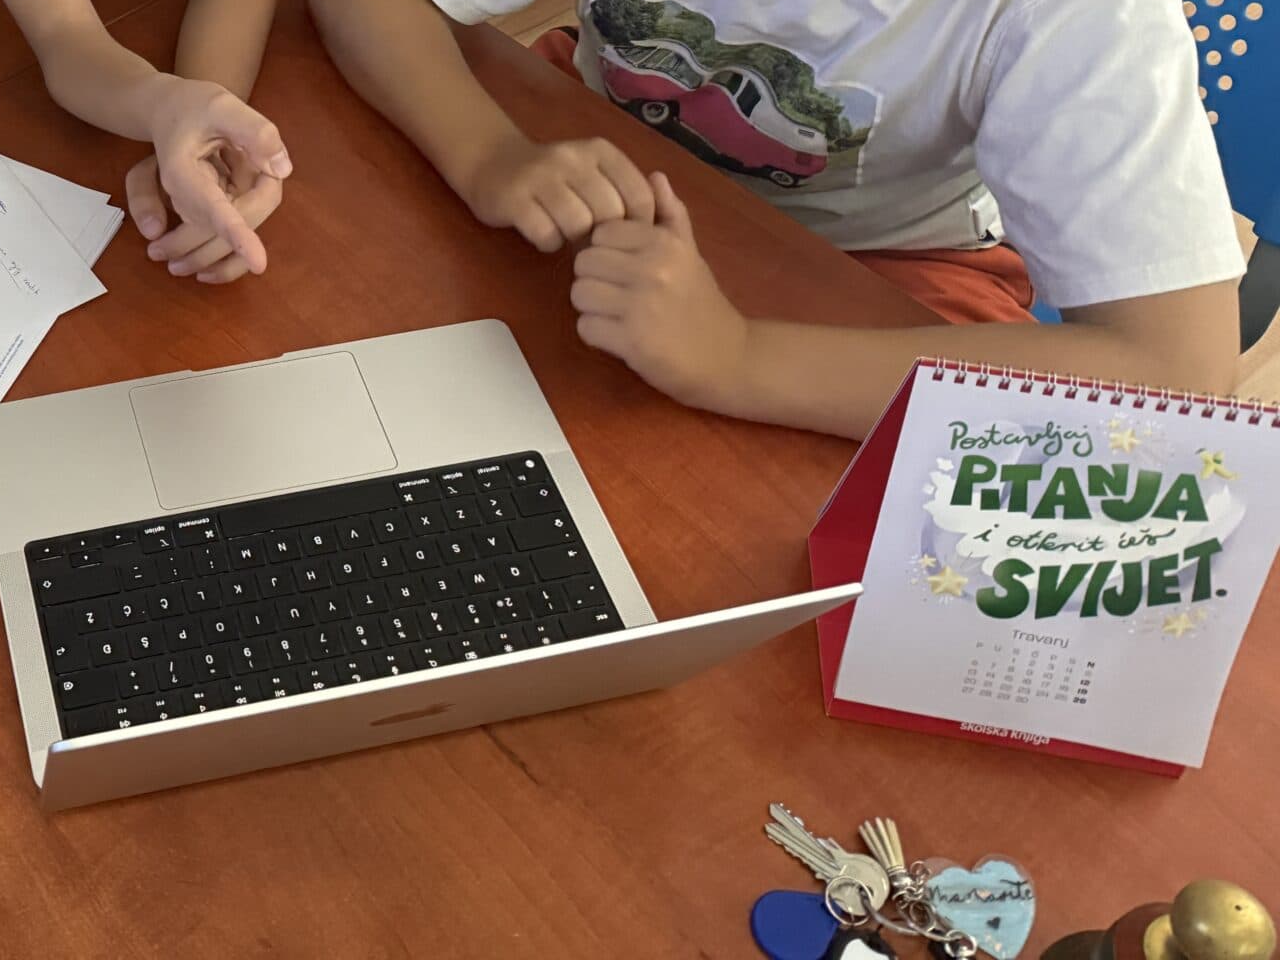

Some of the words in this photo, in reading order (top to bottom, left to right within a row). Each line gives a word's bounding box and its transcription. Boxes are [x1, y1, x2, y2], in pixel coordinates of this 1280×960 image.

[948, 421, 1093, 458] Postavljaj
[950, 454, 1208, 523] PITANJA
[456, 510, 464, 518] Z
[421, 517, 429, 525] X
[386, 523, 394, 531] C
[351, 530, 358, 538] V
[974, 523, 1000, 543] i
[1006, 529, 1105, 552] otkrit
[314, 536, 322, 544] B
[488, 537, 495, 546] A
[278, 543, 286, 551] N
[452, 544, 460, 552] S
[241, 549, 251, 558] M
[416, 551, 424, 559] D
[382, 558, 387, 566] F
[344, 564, 352, 573] G
[511, 568, 519, 576] Q
[307, 571, 315, 580] H
[474, 574, 485, 583] W
[976, 537, 1228, 620] SVIJET.
[272, 578, 277, 586] J
[438, 581, 446, 589] E
[234, 585, 241, 593] K
[401, 588, 409, 596] R
[197, 592, 204, 600] L
[367, 595, 373, 603] T
[543, 591, 549, 599] 1
[502, 598, 512, 606] 2
[329, 602, 336, 611] Y
[468, 605, 476, 613] 3
[291, 609, 299, 618] U
[431, 612, 438, 621] 4
[216, 623, 224, 631] O
[394, 619, 401, 627] 5
[179, 630, 186, 639] P
[356, 626, 364, 635] 6
[321, 633, 326, 642] 7
[1013, 629, 1070, 649] Travanj
[281, 640, 289, 649] 8
[244, 648, 251, 656] 9
[206, 655, 213, 664] 0
